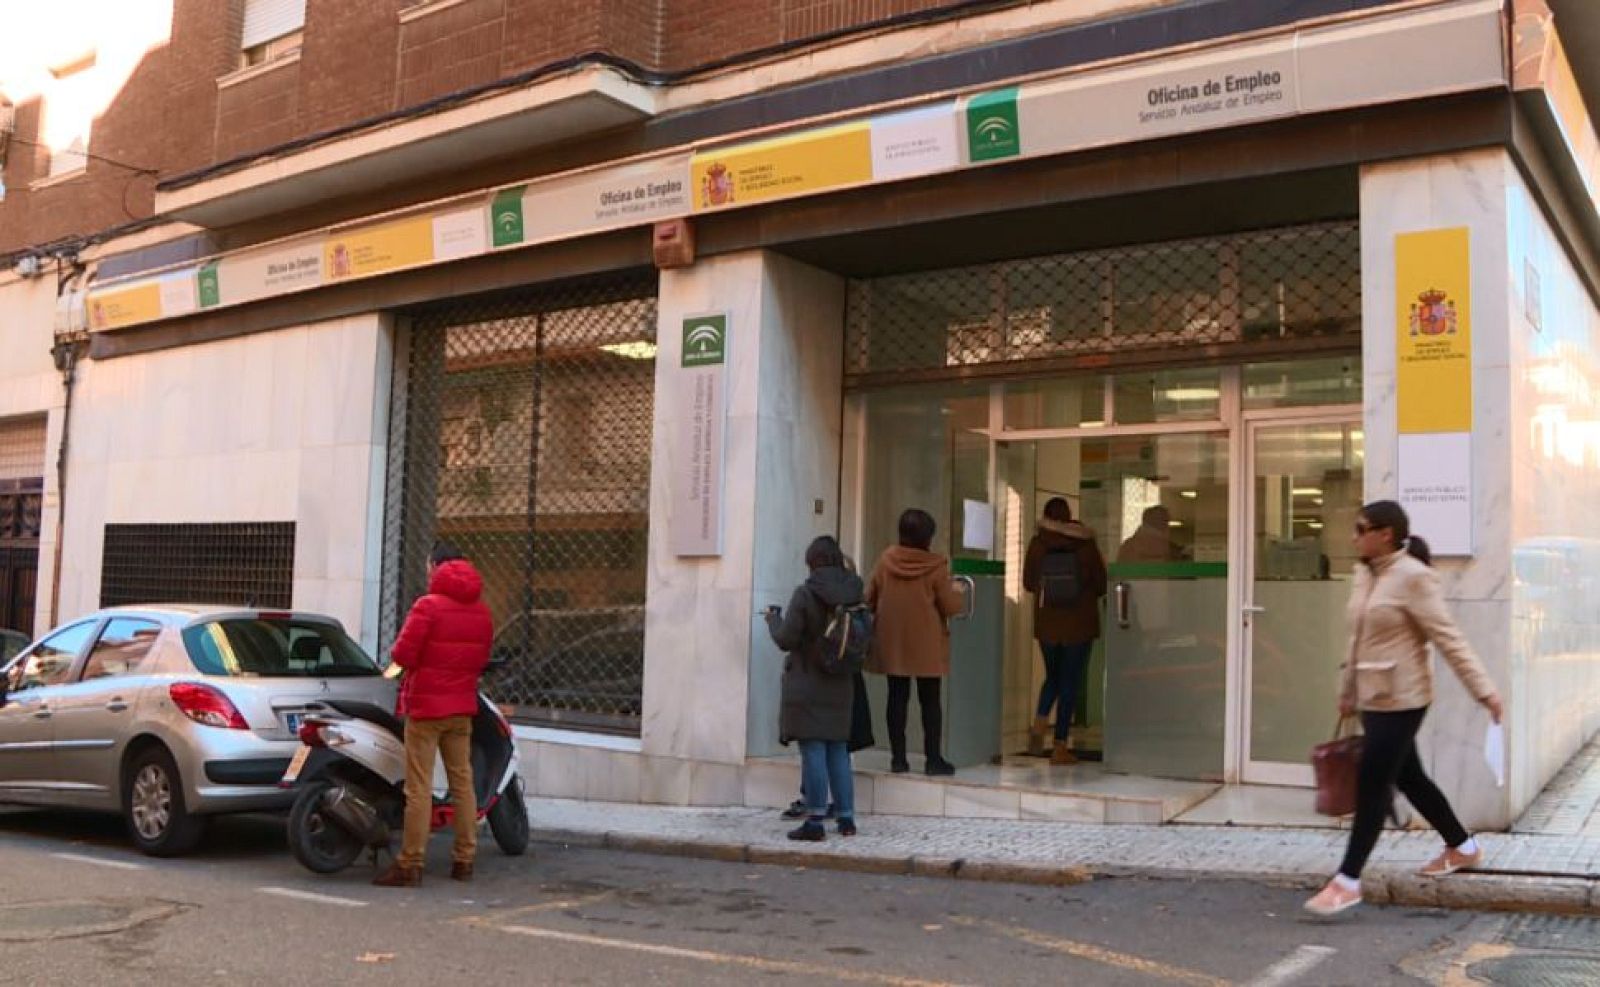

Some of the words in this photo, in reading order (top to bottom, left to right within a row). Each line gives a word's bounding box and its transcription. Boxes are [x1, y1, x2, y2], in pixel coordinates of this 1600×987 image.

[1147, 84, 1199, 105] Oficina
[1203, 79, 1221, 96] de
[1224, 70, 1281, 92] Empleo
[1138, 107, 1177, 122] Servicio
[1180, 101, 1222, 116] Andaluz
[1225, 97, 1239, 109] de
[1243, 90, 1282, 105] Empleo
[600, 190, 633, 206] Oficina
[634, 186, 646, 198] de
[647, 179, 682, 197] Empleo
